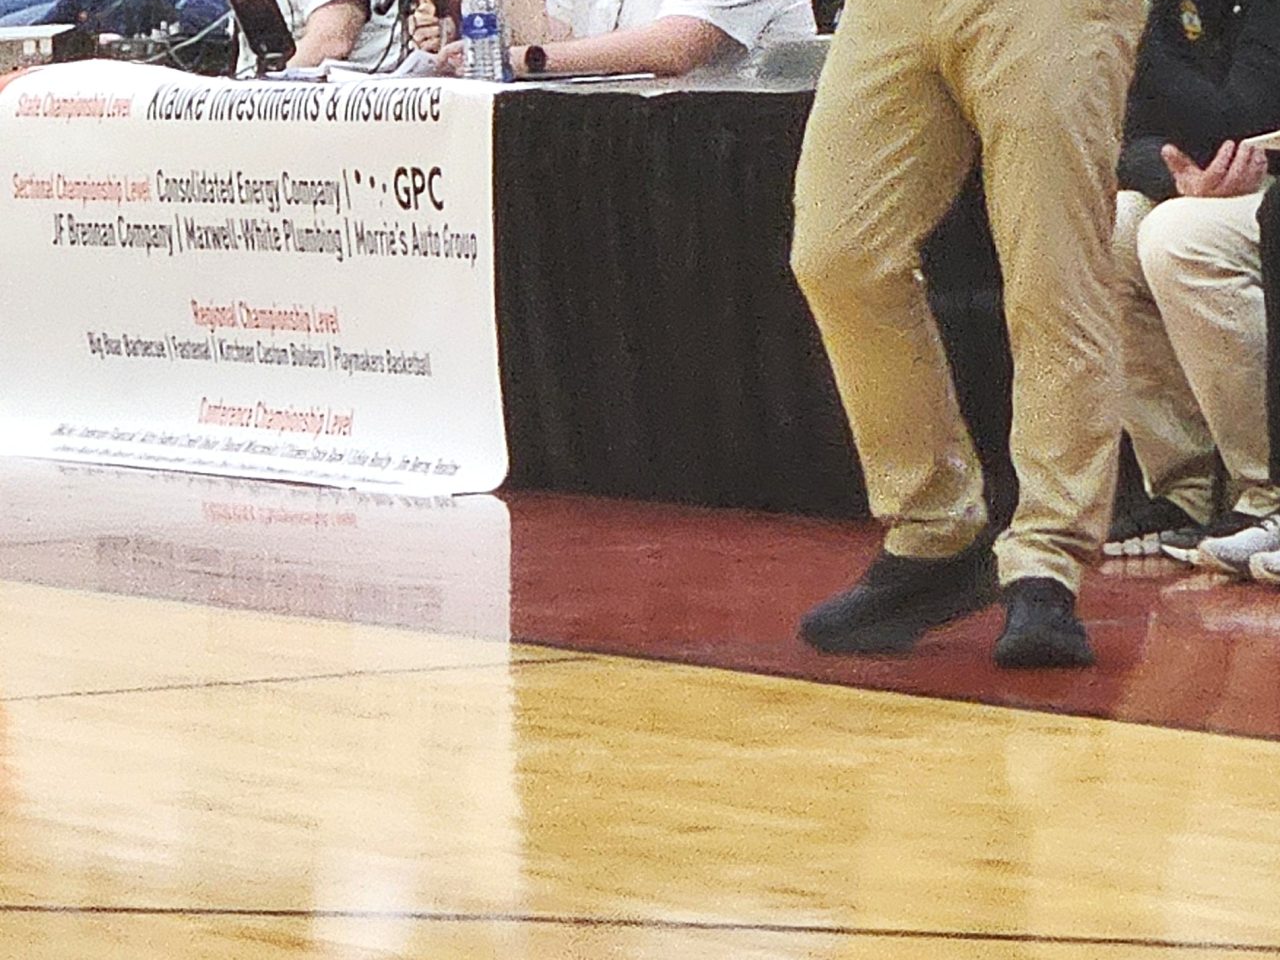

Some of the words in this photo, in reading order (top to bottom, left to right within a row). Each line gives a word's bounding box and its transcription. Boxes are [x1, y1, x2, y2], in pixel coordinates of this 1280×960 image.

[43, 91, 106, 124] Championship
[208, 86, 323, 122] Investments
[343, 85, 442, 122] Insurance
[56, 173, 123, 208] Championship
[156, 169, 236, 204] Consolidated
[237, 171, 281, 213] Energy
[281, 171, 341, 214] Company
[393, 166, 445, 212] GPC
[67, 213, 117, 247] Brennan
[118, 215, 173, 256] Company
[184, 216, 282, 252] Maxwell-White
[283, 218, 344, 263] Plumbing
[354, 220, 409, 257] Morrie's
[411, 222, 441, 258] Auto
[442, 223, 478, 268] Group
[238, 301, 311, 340] Championship
[253, 400, 326, 440] Championship
